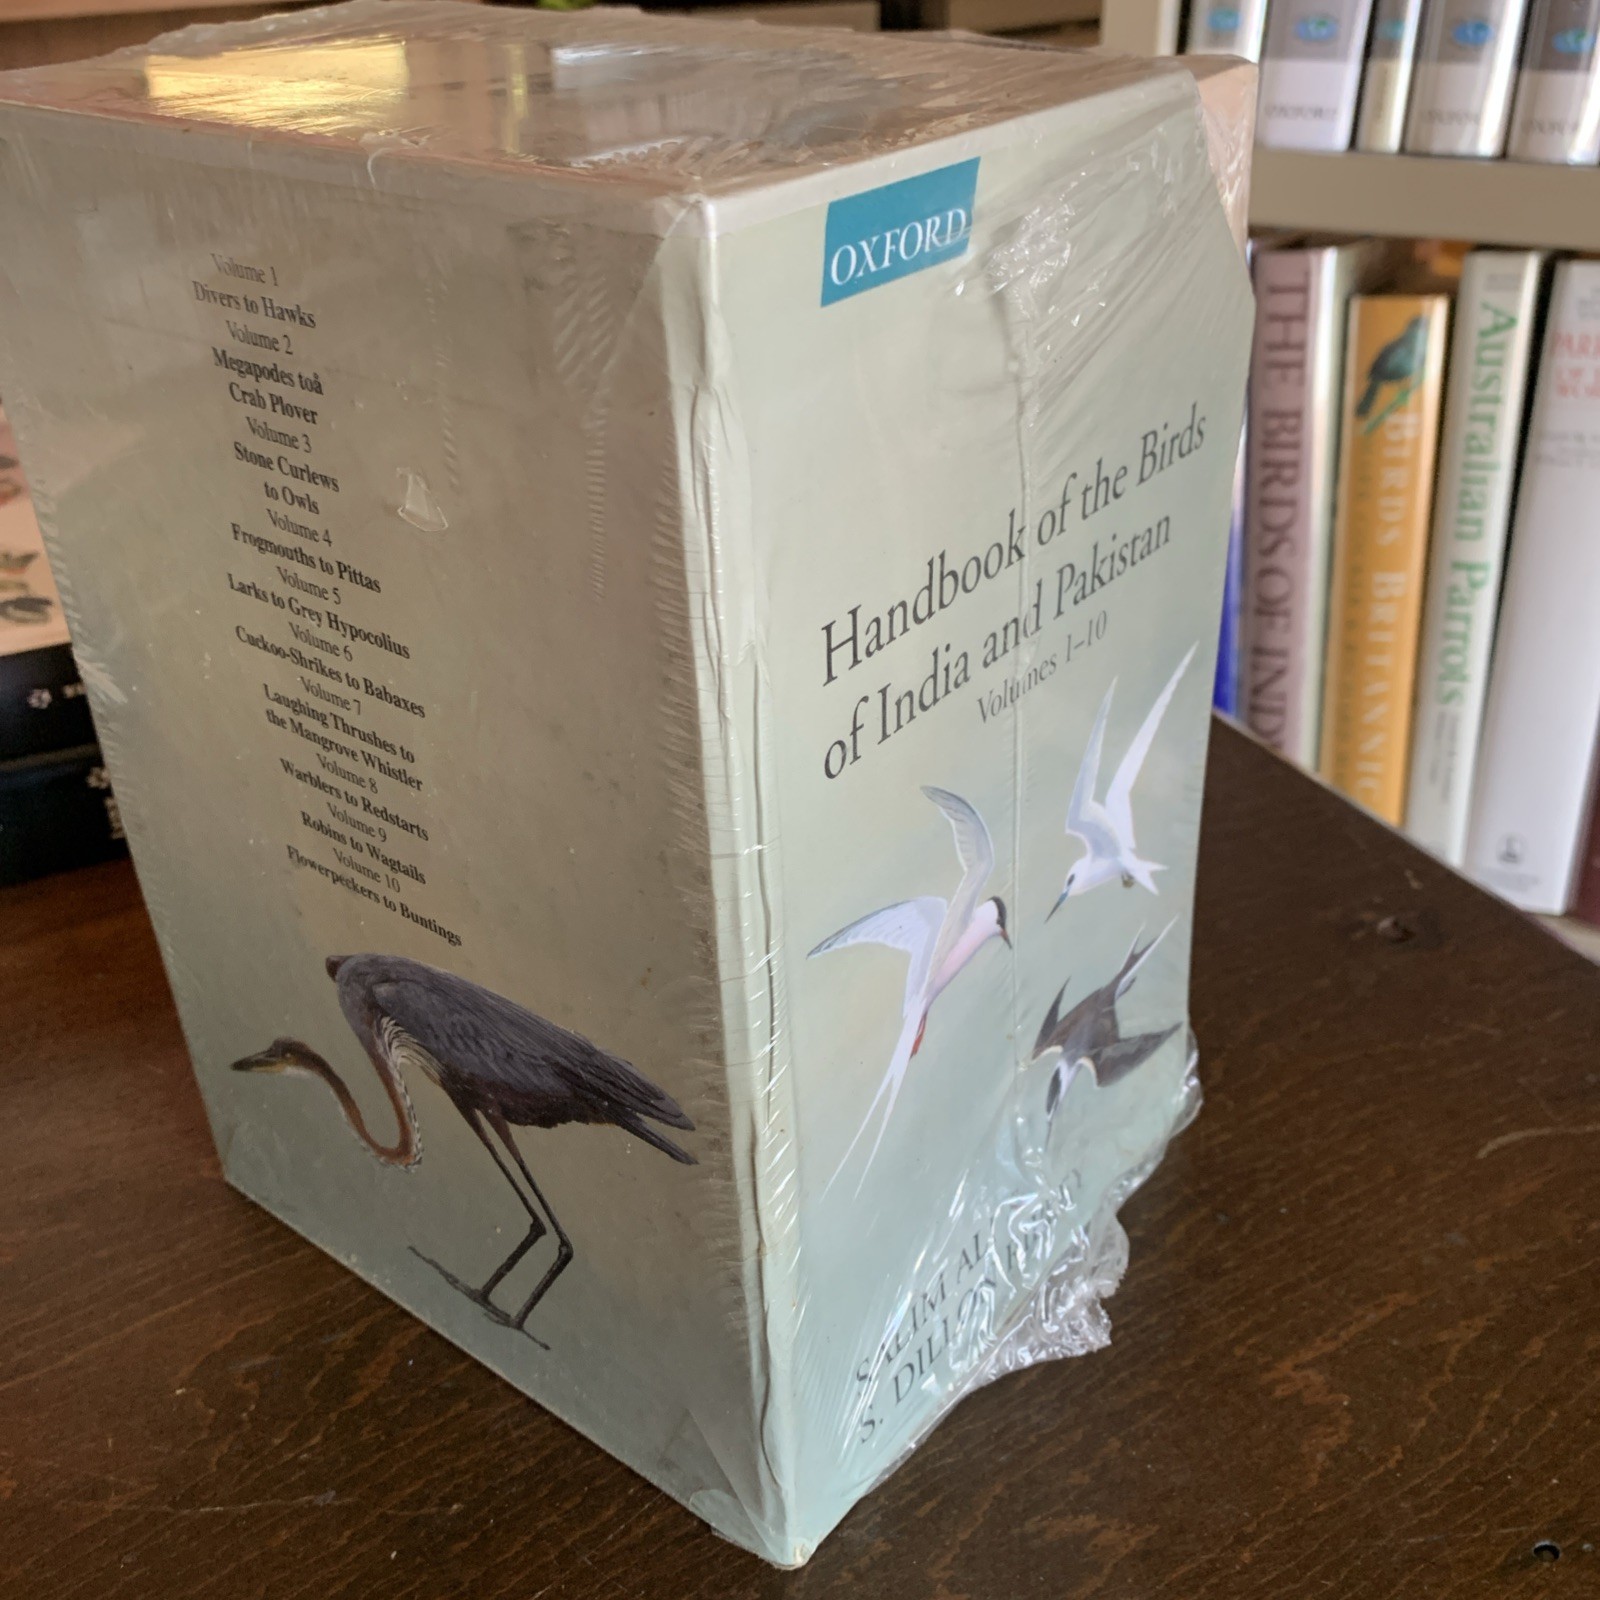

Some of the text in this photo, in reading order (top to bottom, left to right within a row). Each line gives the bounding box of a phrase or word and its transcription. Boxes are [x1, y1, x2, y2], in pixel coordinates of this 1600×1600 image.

[210, 253, 279, 287] Volume 1
[830, 207, 968, 289] OXFORD
[192, 280, 316, 329] Divers to Hawks
[226, 320, 294, 355] Volume 2
[211, 346, 296, 389] Megapodes
[229, 382, 319, 425] Crab Plover
[246, 416, 313, 454] Volume 3
[1454, 302, 1519, 542] Australian
[233, 441, 341, 493] Stone Curlews
[263, 481, 321, 515] to Owls
[266, 508, 333, 548] Volume 4
[820, 403, 1207, 688] Handbook of the Birds
[1248, 270, 1309, 750] THE BIRDS OF IND
[231, 522, 382, 594] Frogmouths to Pittas
[276, 566, 342, 605] Volume 5
[227, 572, 411, 660] Larks to Grey Hypocolius
[288, 621, 353, 662] Volume 6
[823, 514, 1173, 781] of India and Pakistan
[1436, 560, 1492, 706] Parrots
[235, 625, 426, 719] Cuckoo-Shrikes to Babaxes
[300, 676, 362, 716] Volume 7
[975, 651, 1058, 726] Volumes
[263, 683, 416, 765] Laughing Thrushes to
[265, 708, 424, 792] the Mangrove Whistler
[280, 757, 430, 842] Warblers to Redstarts
[316, 753, 379, 795] Volume 8
[301, 810, 427, 885] Robins to Wagtails
[326, 802, 388, 844] Volume 9
[286, 844, 463, 947] Flowerpeckers to Buntings
[332, 848, 402, 894] Volume 10
[892, 1275, 997, 1407] DILLO
